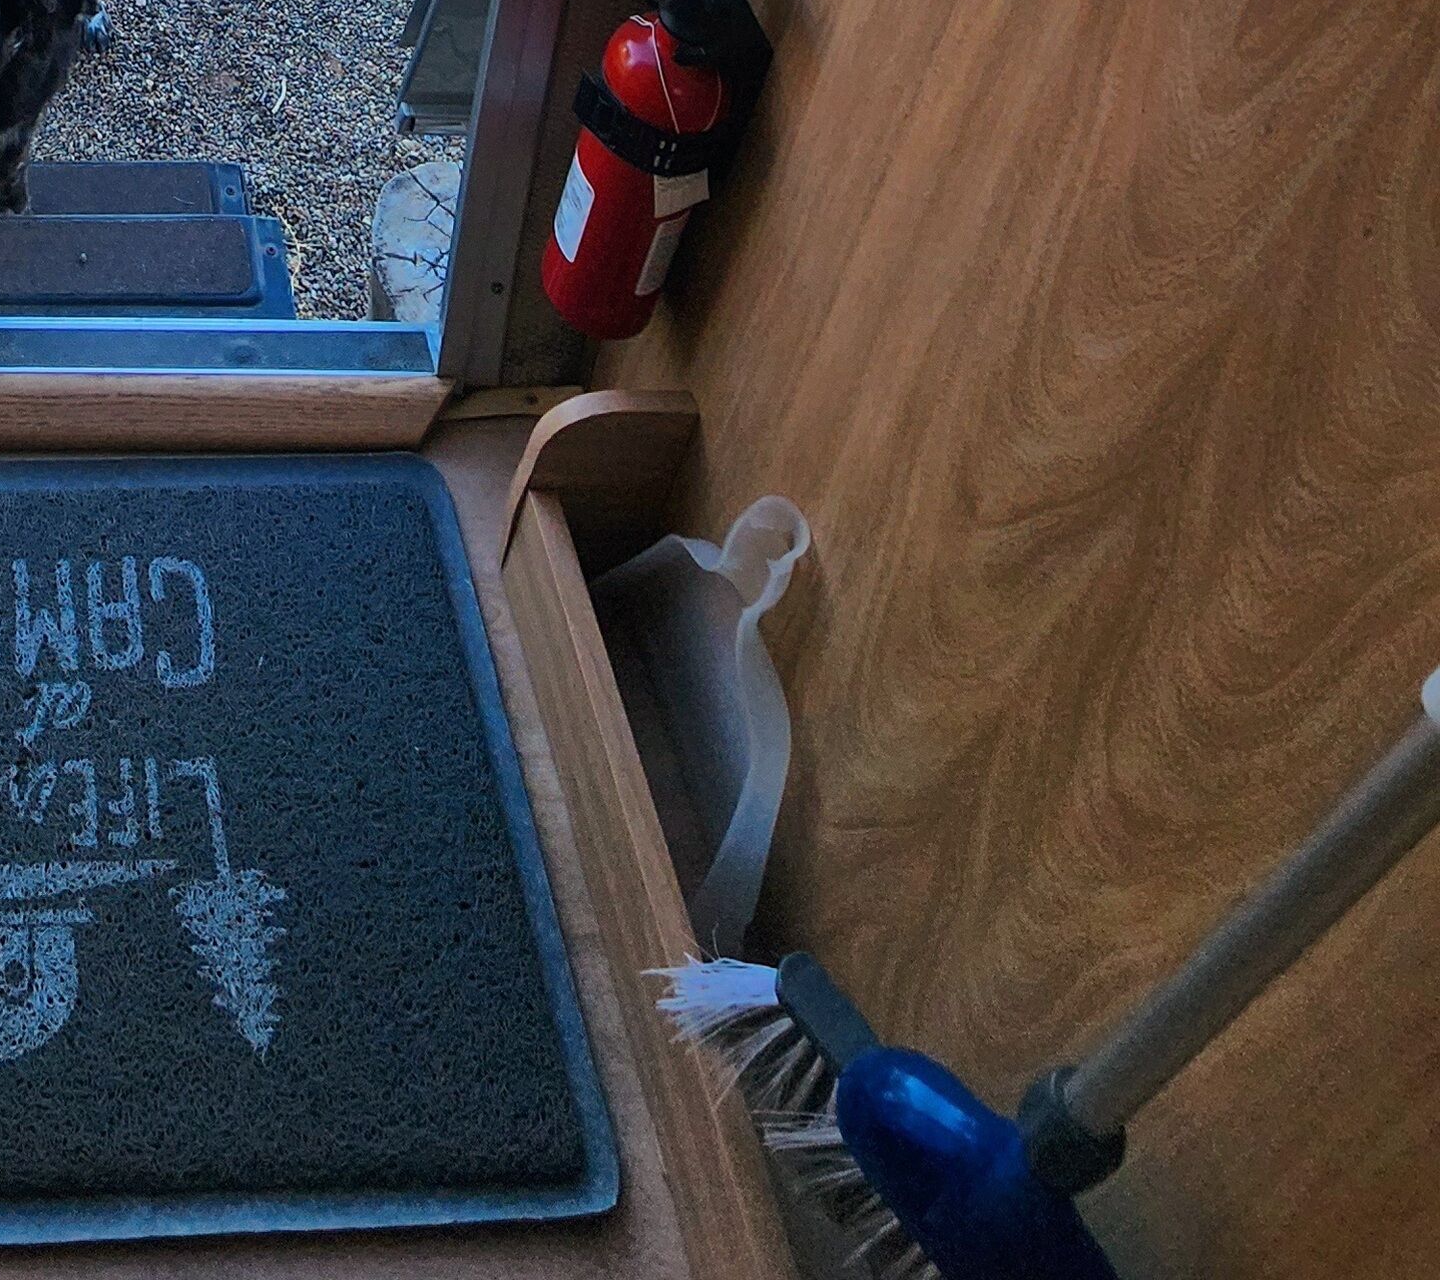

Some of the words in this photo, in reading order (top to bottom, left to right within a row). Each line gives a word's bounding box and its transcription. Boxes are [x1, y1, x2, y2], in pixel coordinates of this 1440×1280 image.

[13, 679, 92, 748] at
[2, 757, 56, 827] is
[64, 756, 228, 882] LIFE
